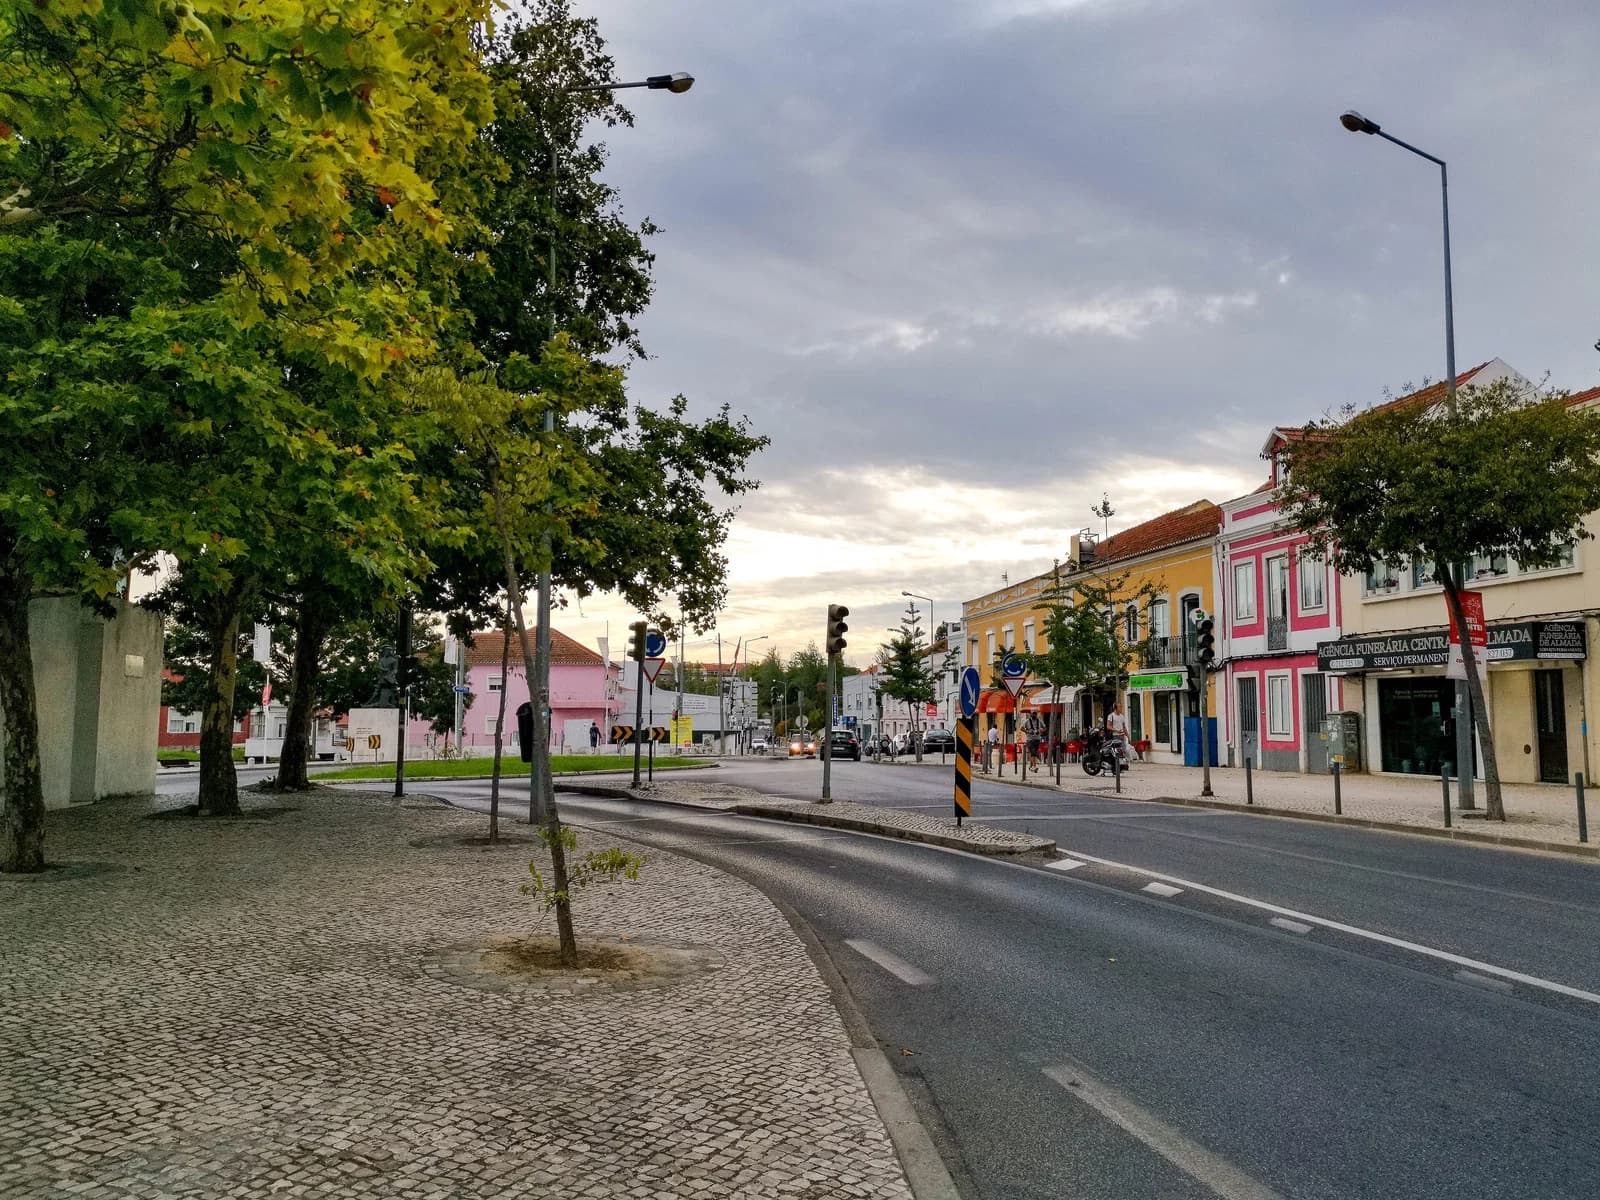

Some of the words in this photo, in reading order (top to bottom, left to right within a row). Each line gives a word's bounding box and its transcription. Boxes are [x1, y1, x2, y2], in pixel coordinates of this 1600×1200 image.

[1543, 623, 1577, 632] AGÊNCIA
[1318, 643, 1355, 658] AGÊNCIA
[1355, 637, 1410, 656] FUNERÁRIA
[1410, 636, 1450, 651] CENTRA
[1486, 628, 1532, 645] LMADA
[1373, 656, 1403, 667] SERVIÇO
[1403, 653, 1449, 664] PERMANENT
